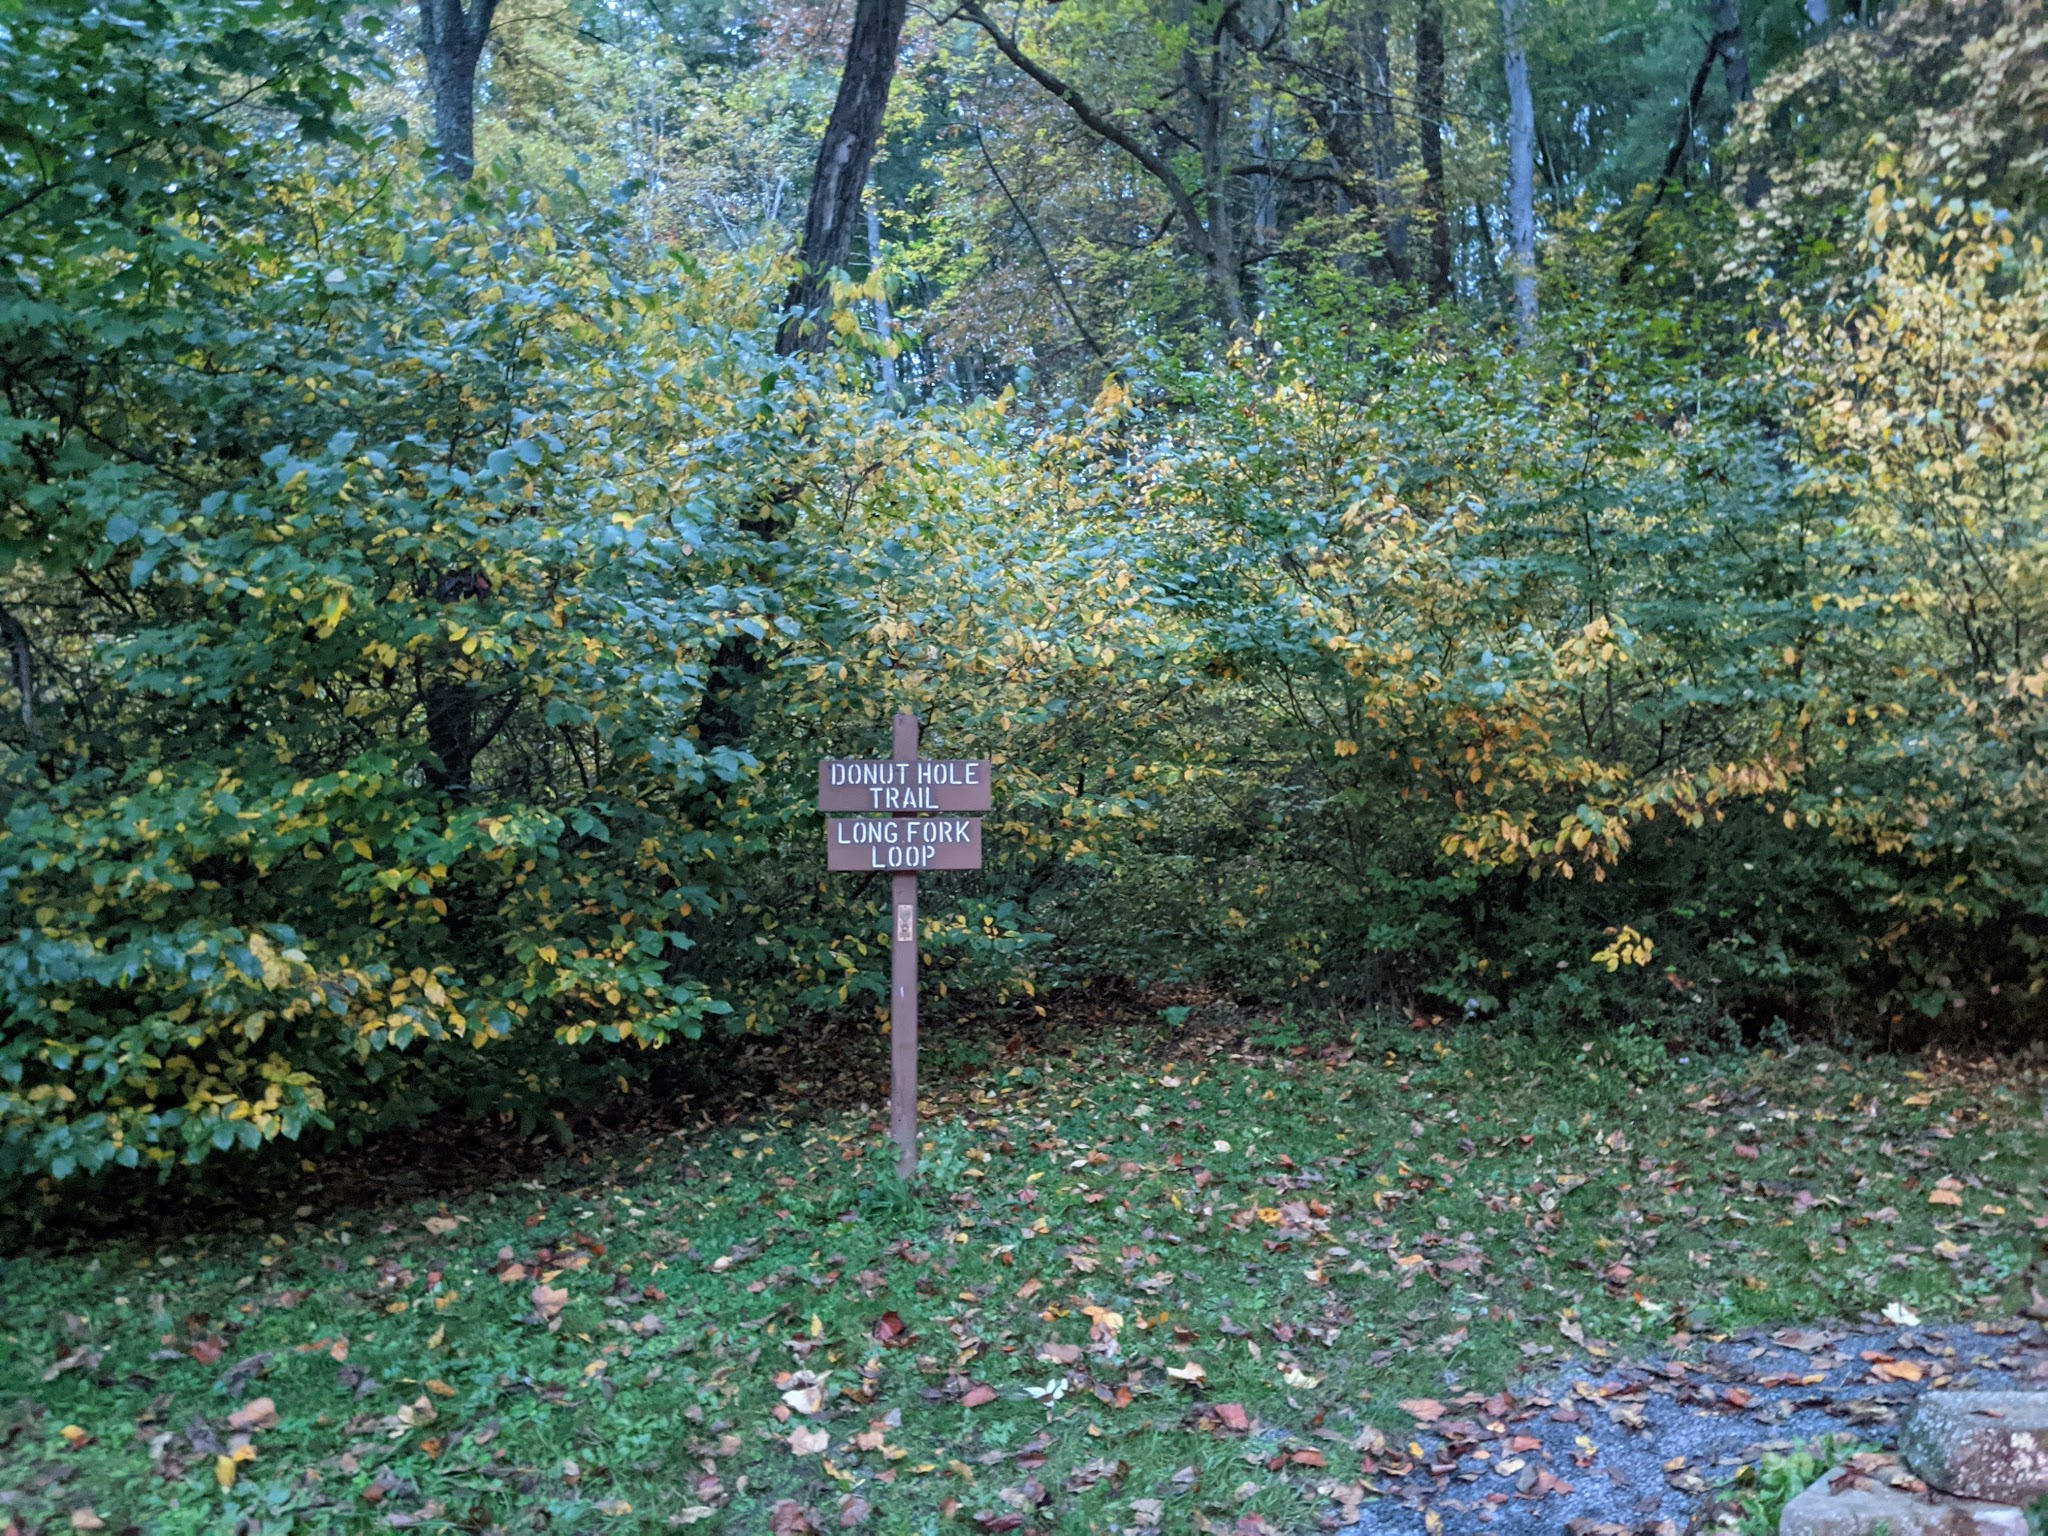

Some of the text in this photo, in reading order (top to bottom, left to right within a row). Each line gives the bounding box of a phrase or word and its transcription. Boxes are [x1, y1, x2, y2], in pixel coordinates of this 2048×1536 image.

[831, 763, 979, 785] DONUT HOLE
[869, 787, 939, 809] TRAIL
[837, 821, 971, 844] LONG FORK
[872, 846, 936, 868] LOOP
